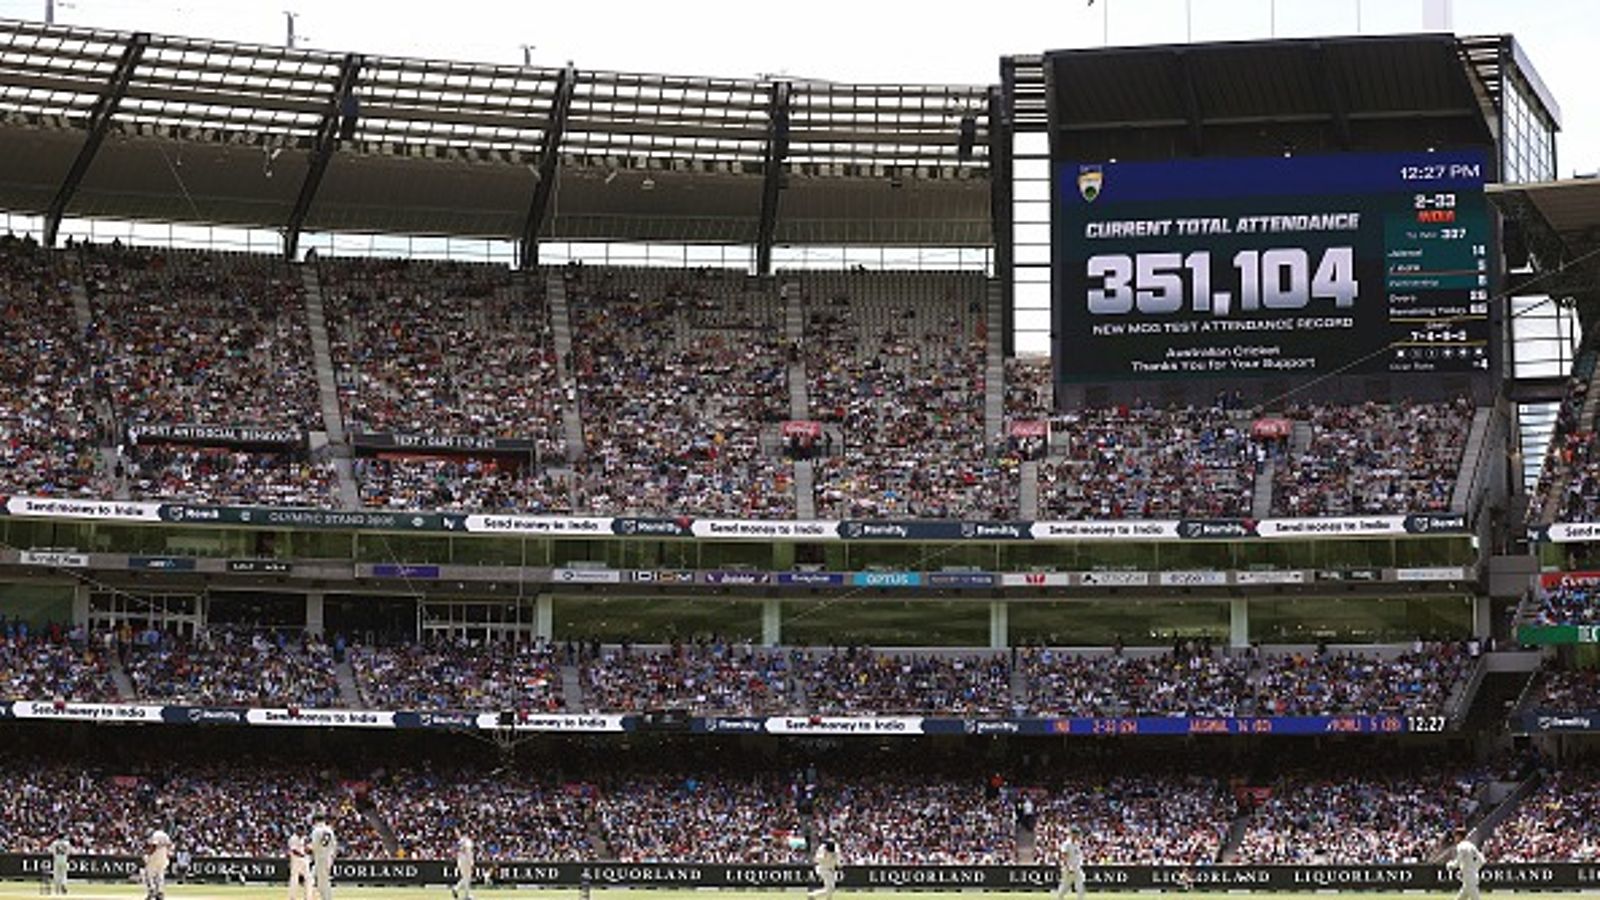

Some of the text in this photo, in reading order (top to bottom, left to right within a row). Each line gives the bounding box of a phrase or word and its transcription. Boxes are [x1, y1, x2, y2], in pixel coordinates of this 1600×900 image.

[1401, 164, 1480, 180] 12:27 PM
[1085, 213, 1361, 239] CURRENT TOTAL ATTENDANCE
[1087, 246, 1359, 316] 351,104
[1093, 317, 1353, 336] NEW MCG TEST ATTENDANCE RECORD
[1165, 345, 1280, 358] Australian Cricket
[1131, 357, 1316, 371] Thanks You for Your Support
[26, 501, 144, 516] Send money to India
[269, 511, 396, 526] OLYMPIC STAND 2006
[484, 517, 599, 531] Send money to India
[710, 522, 824, 536] Send money to India
[863, 524, 908, 537] Remitly
[977, 524, 1020, 537] Remitly
[1050, 524, 1164, 537] Send money to India
[1203, 523, 1248, 536] Remitly
[1276, 519, 1391, 534] Send money to India
[1565, 526, 1592, 537] Send
[866, 573, 908, 585] OPTUS
[101, 706, 114, 716] to
[116, 706, 146, 717] India
[203, 709, 241, 721] Remitly
[334, 714, 346, 723] to
[350, 713, 378, 723] India
[432, 715, 471, 726] Remitly
[565, 717, 577, 727] to
[578, 717, 606, 728] India
[719, 718, 760, 731] Remitly
[859, 720, 871, 731] to
[874, 719, 906, 731] India
[977, 721, 1018, 734] Remitly
[1407, 716, 1446, 732] 12:27
[22, 859, 138, 875] LIQORLAND
[332, 864, 419, 879] UORLAND
[580, 867, 702, 882] LIQUORLAND
[726, 869, 845, 885] LIQUORLAD
[869, 870, 985, 886] LIQUORLAND
[1009, 871, 1128, 885] LIQUAND
[1152, 870, 1270, 885] LIQORLAND
[1294, 869, 1413, 886] LIQUORLAND
[1437, 868, 1554, 882] LIORLAND
